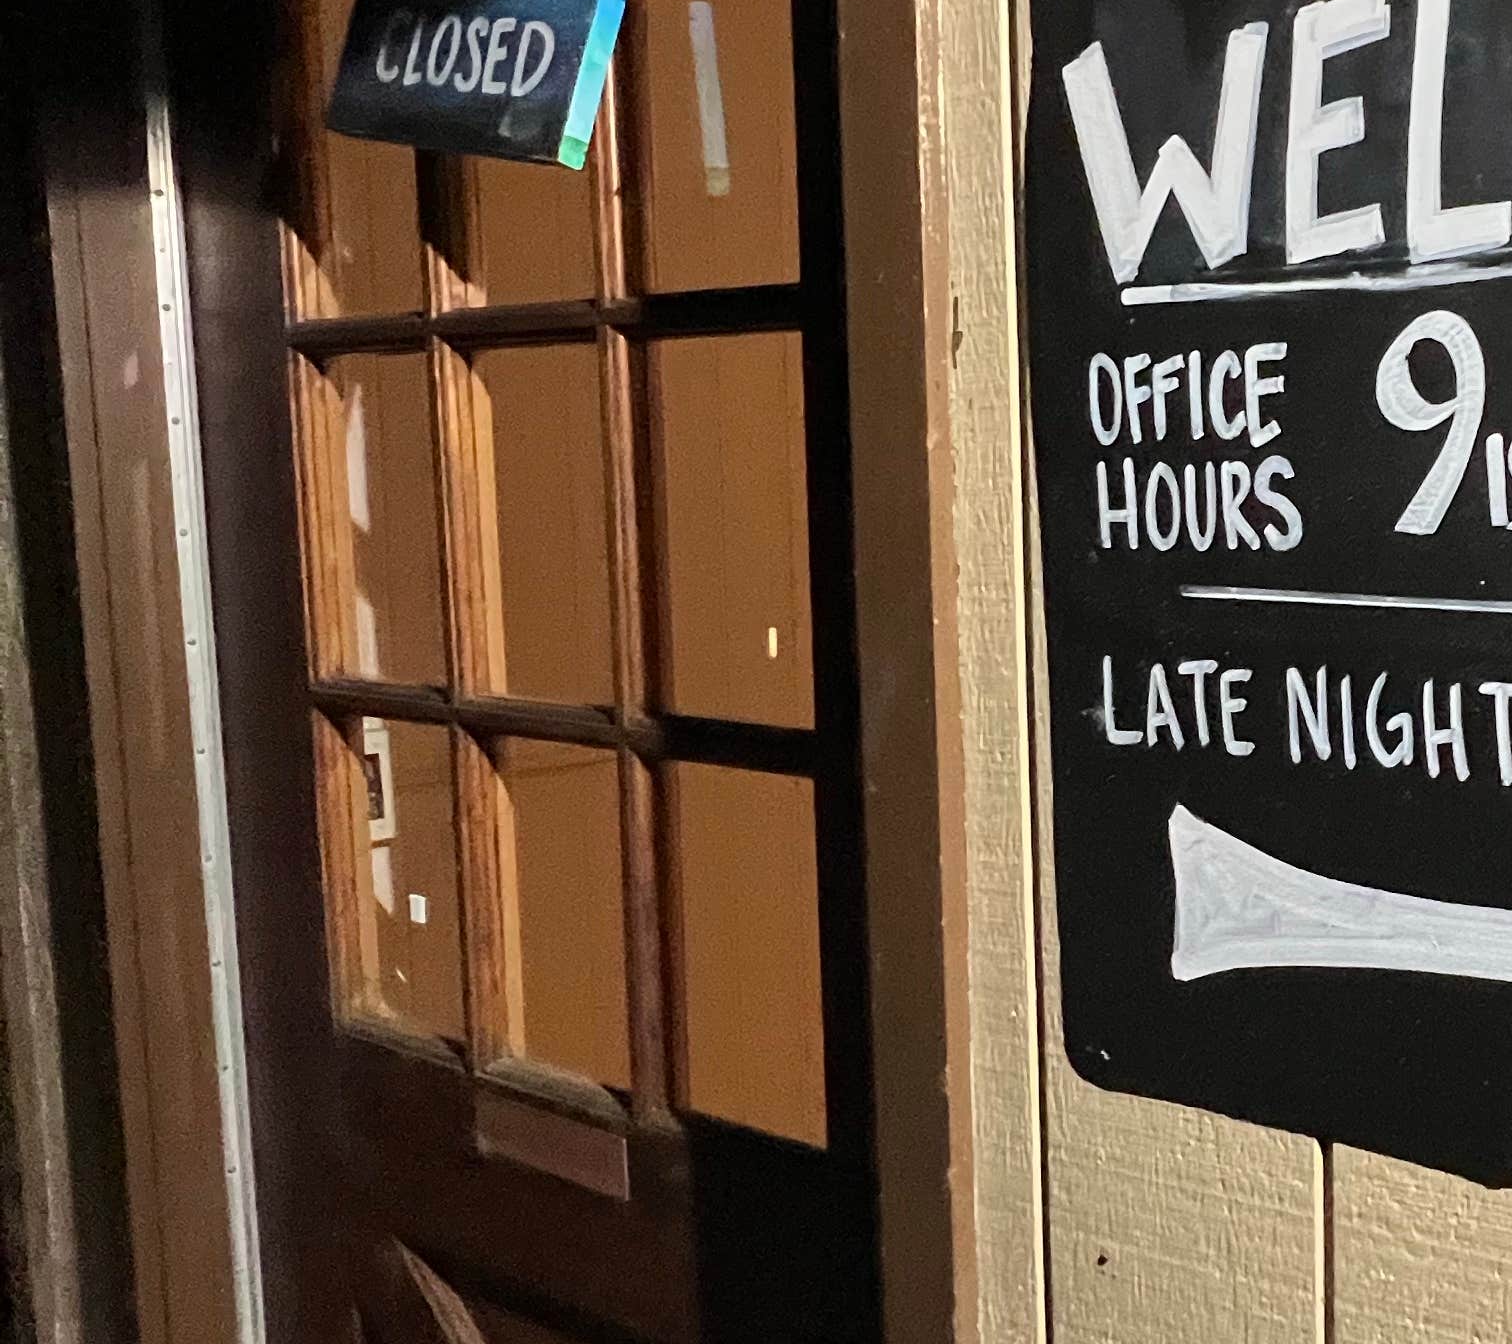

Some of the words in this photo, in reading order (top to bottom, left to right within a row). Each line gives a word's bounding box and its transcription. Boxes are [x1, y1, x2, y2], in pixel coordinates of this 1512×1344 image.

[375, 8, 556, 97] CLOSED
[1088, 342, 1288, 448] OFFICE
[1096, 455, 1303, 552] HOURS
[1102, 655, 1256, 756] LATE
